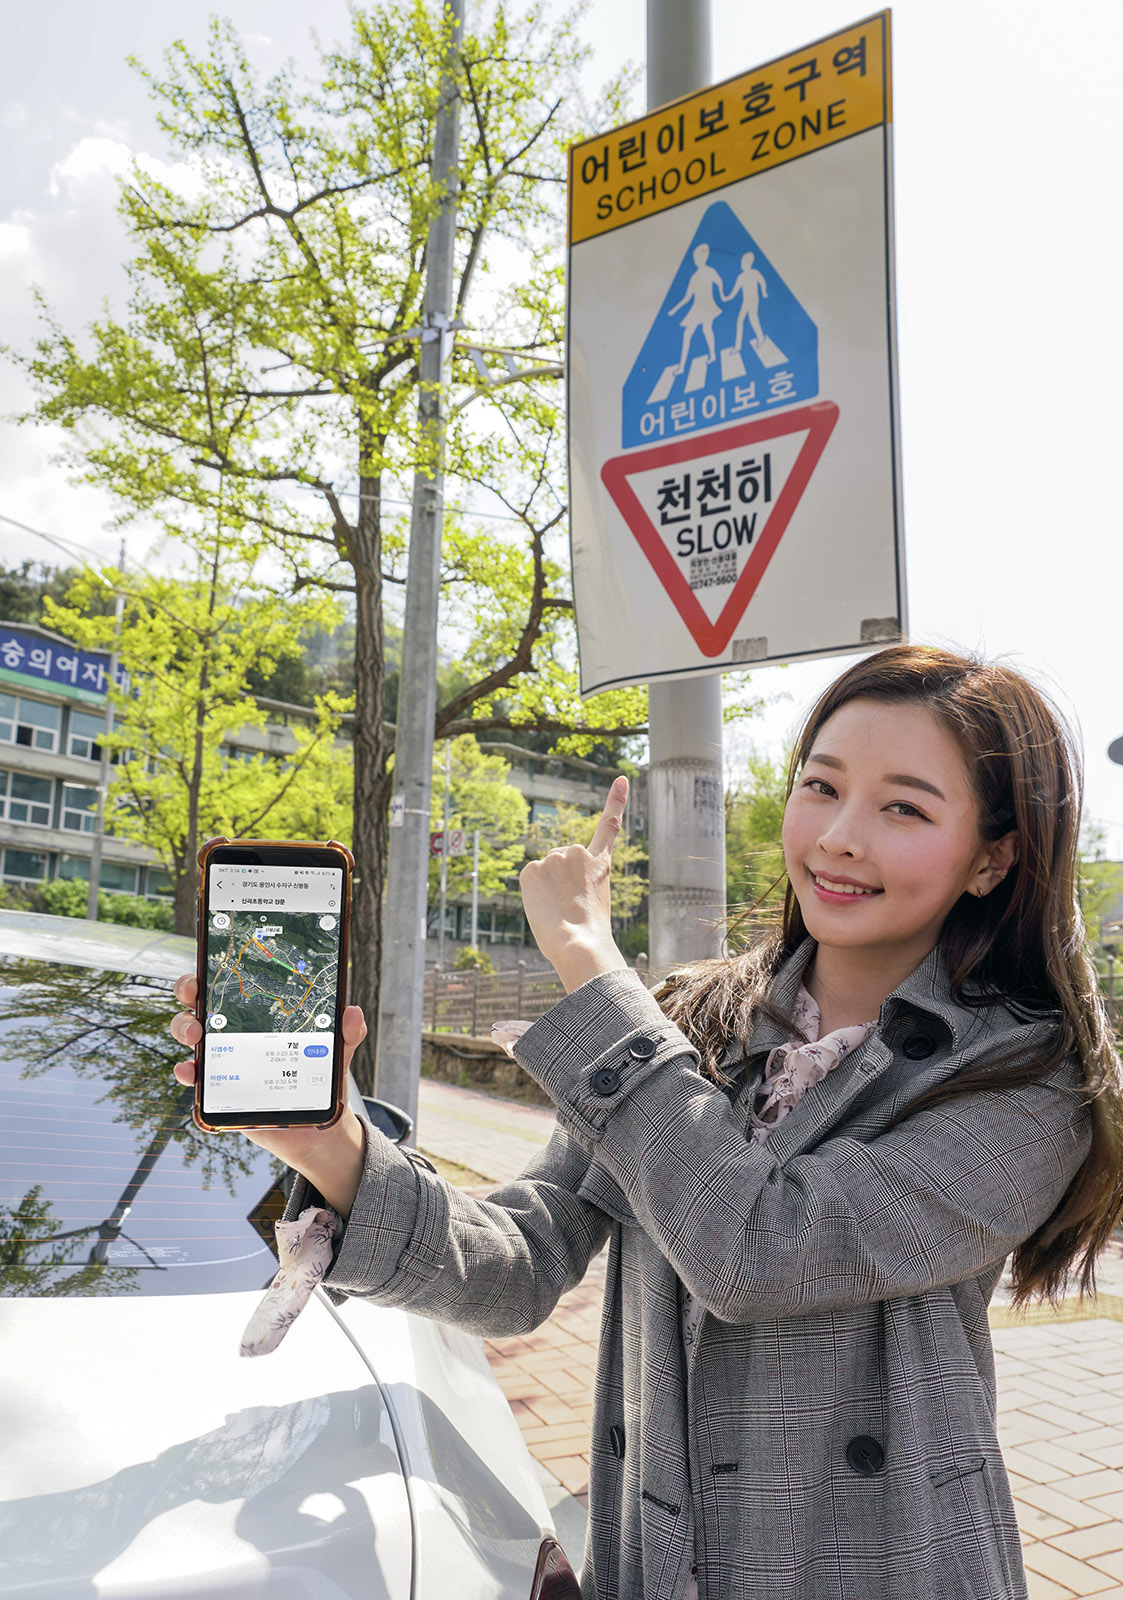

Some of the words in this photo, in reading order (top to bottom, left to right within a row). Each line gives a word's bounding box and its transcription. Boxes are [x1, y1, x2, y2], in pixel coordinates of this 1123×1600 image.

[581, 35, 867, 184] 어린이보호구역
[596, 152, 726, 221] SCHOOL
[751, 98, 847, 161] ZONE
[639, 370, 797, 436] 어린이보호
[656, 452, 772, 526] 천천히
[676, 511, 758, 558] SLOW
[0, 638, 143, 697] 숭의여자대
[282, 1070, 298, 1078] 16분
